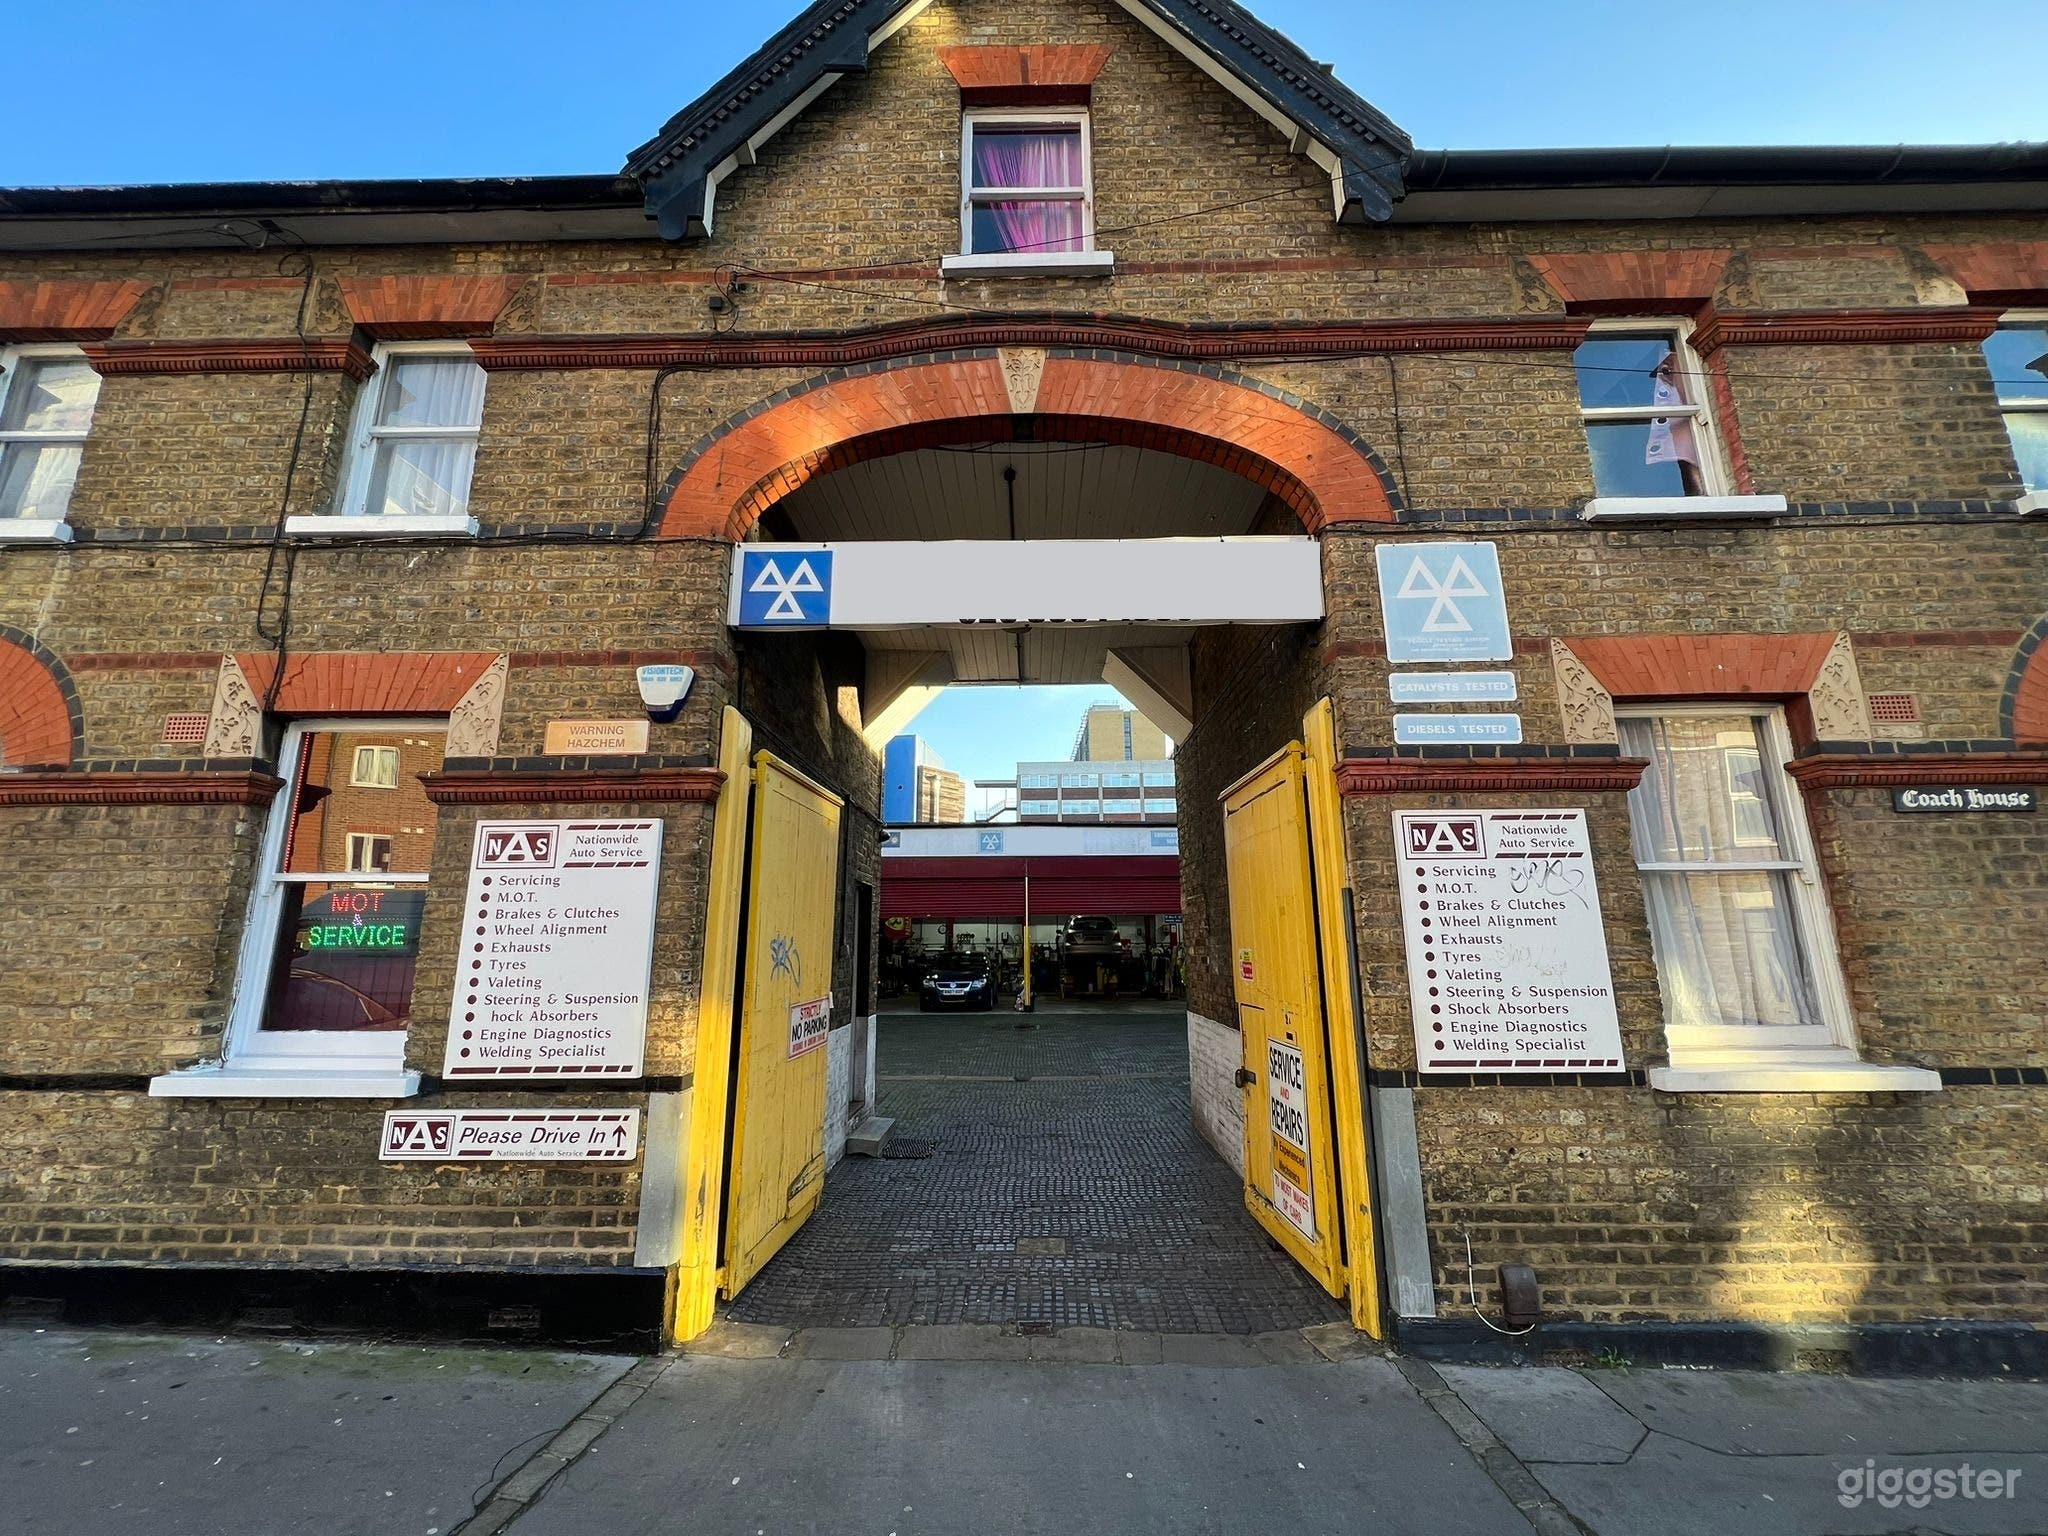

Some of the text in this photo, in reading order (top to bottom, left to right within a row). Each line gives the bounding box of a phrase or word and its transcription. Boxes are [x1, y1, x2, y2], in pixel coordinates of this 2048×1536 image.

[1398, 682, 1508, 692] CATALYSTS TESTED
[570, 726, 624, 735] WARNING
[1408, 725, 1507, 734] DIESELS TESTED
[568, 739, 625, 748] HAZCHEM
[1902, 789, 1963, 808] Coach
[1502, 825, 1568, 835] Nationwide
[575, 834, 639, 845] Nationwide
[1412, 823, 1475, 852] NAS
[1499, 838, 1575, 848] Auto Service
[487, 832, 548, 862] NAS
[569, 847, 643, 858] Auto Service
[1433, 866, 1497, 879] Servicing
[499, 875, 561, 888] Servicing
[1435, 883, 1477, 894] M.O.T.
[331, 893, 384, 912] MOT
[497, 892, 538, 902] M.O.T.
[1437, 899, 1566, 911] Brakes & Clutches
[495, 907, 619, 919] Brakes & Clutches
[352, 914, 362, 926] &
[1439, 915, 1558, 929] Wheel Alignment
[309, 925, 405, 946] SERVICE
[494, 924, 607, 938] Wheel Alignment
[1441, 933, 1503, 945] Exhausts
[491, 942, 551, 953] Exhausts
[1443, 951, 1481, 964] Tyres
[489, 959, 527, 972] Tyres
[1445, 969, 1502, 983] Valeting
[488, 976, 543, 990] Valeting
[1446, 985, 1608, 1000] Steering & Suspension
[484, 994, 639, 1007] Steering & Suspension
[1448, 1003, 1569, 1015] Shock Absorbers
[530, 1010, 599, 1022] Absorbers
[792, 1015, 826, 1042] NO PARKING
[1450, 1021, 1588, 1035] Engine Diagnostics
[480, 1028, 612, 1043] Engine Diagnostics
[479, 1045, 606, 1060] Welding Specialist
[1453, 1039, 1586, 1053] Welding Specialist
[1270, 1047, 1301, 1090] SERVICE
[1281, 1086, 1289, 1100] AND
[1272, 1096, 1303, 1146] REPAIRS
[392, 1121, 448, 1150] NAS
[459, 1127, 606, 1144] Please Drive In
